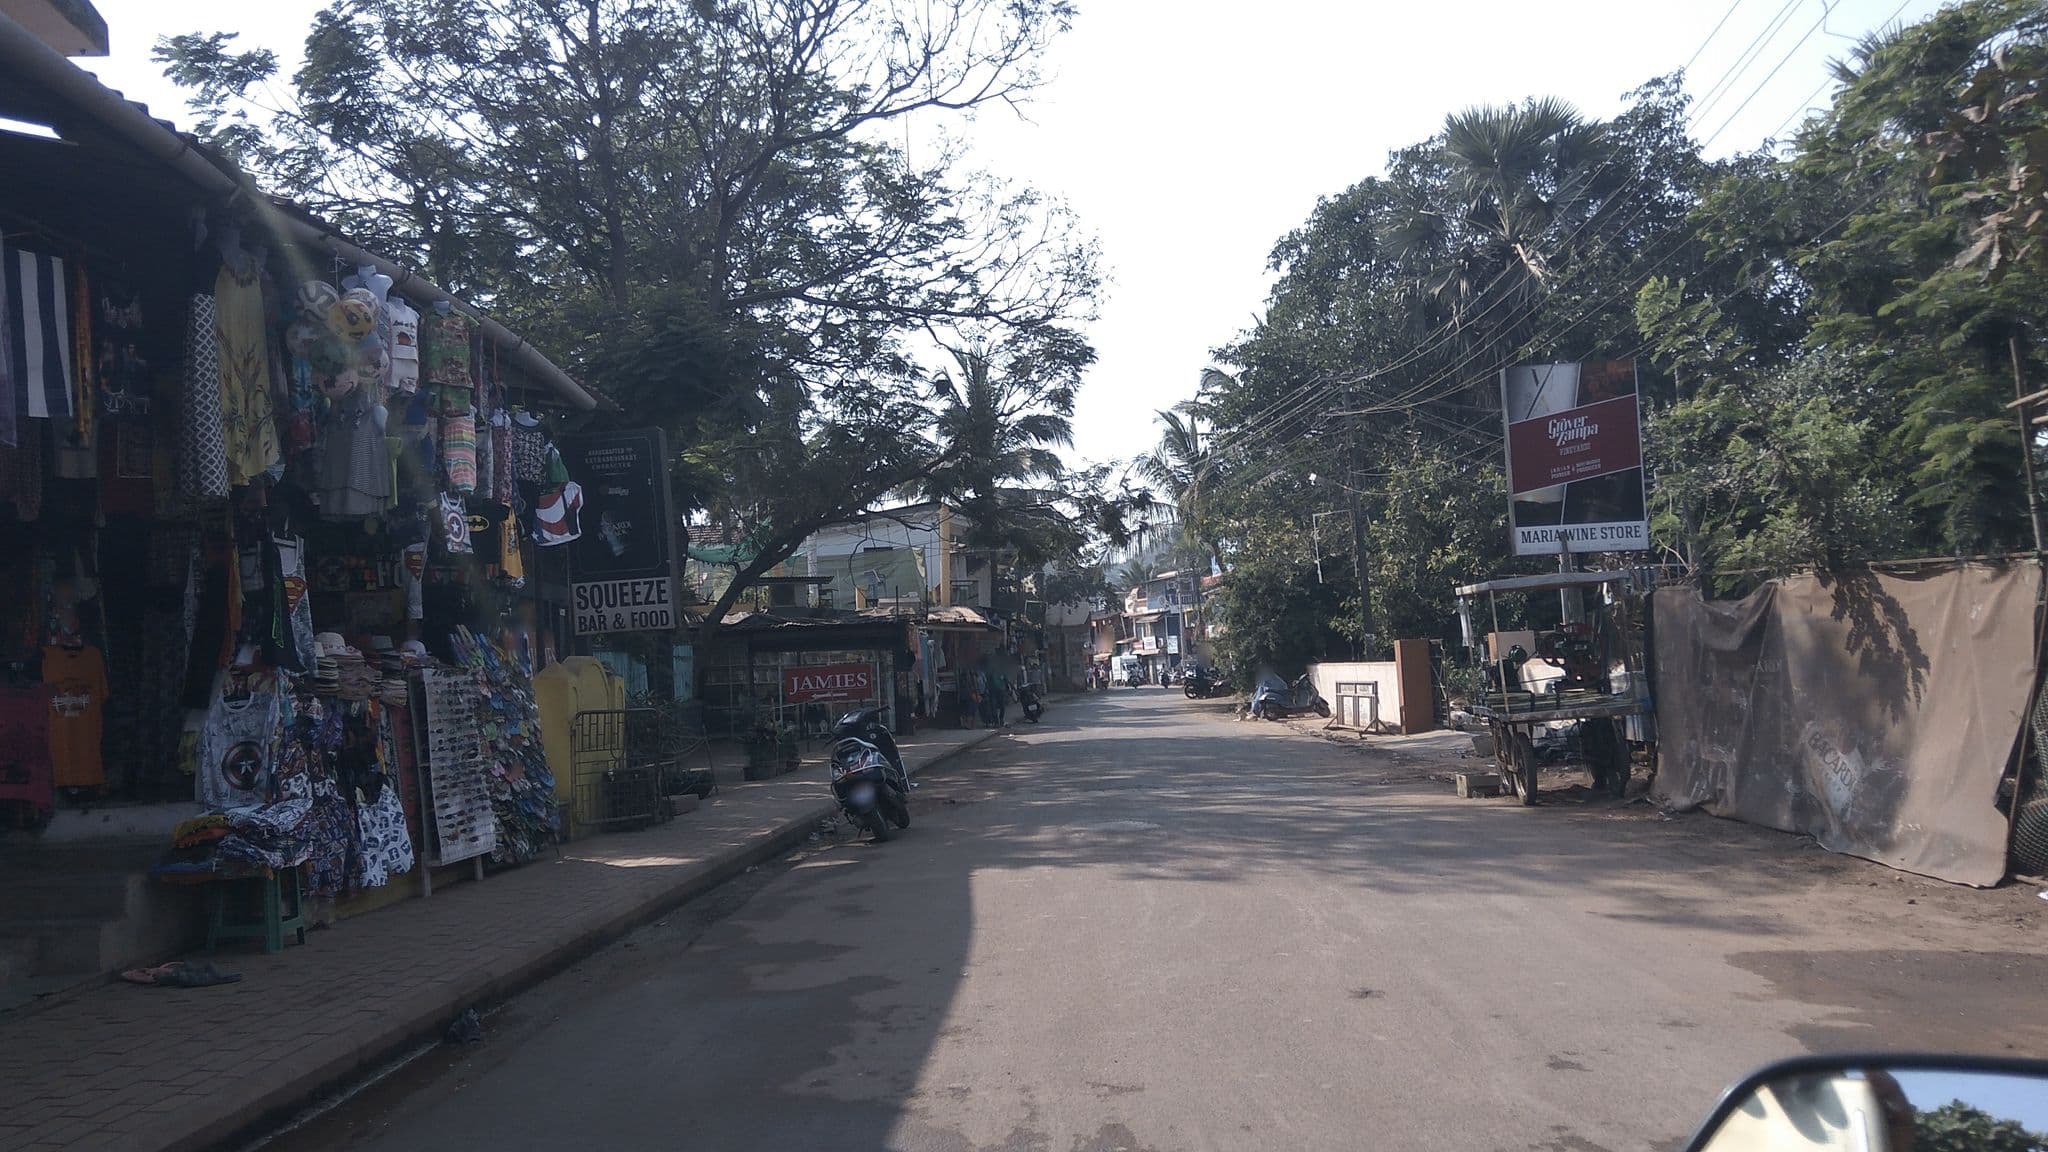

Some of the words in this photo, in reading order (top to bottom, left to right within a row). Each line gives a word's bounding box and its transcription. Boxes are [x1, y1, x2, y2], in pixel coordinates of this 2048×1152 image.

[1548, 415, 1588, 440] Grover
[1556, 423, 1599, 446] Zampa
[1521, 529, 1561, 544] MARIA
[1565, 527, 1597, 541] WINE
[1600, 525, 1642, 540] STORE
[576, 579, 669, 614] SQUEEZE
[577, 614, 607, 633] BAR
[613, 612, 626, 630] &
[631, 609, 669, 628] FOOD
[789, 672, 867, 695] JAMIES
